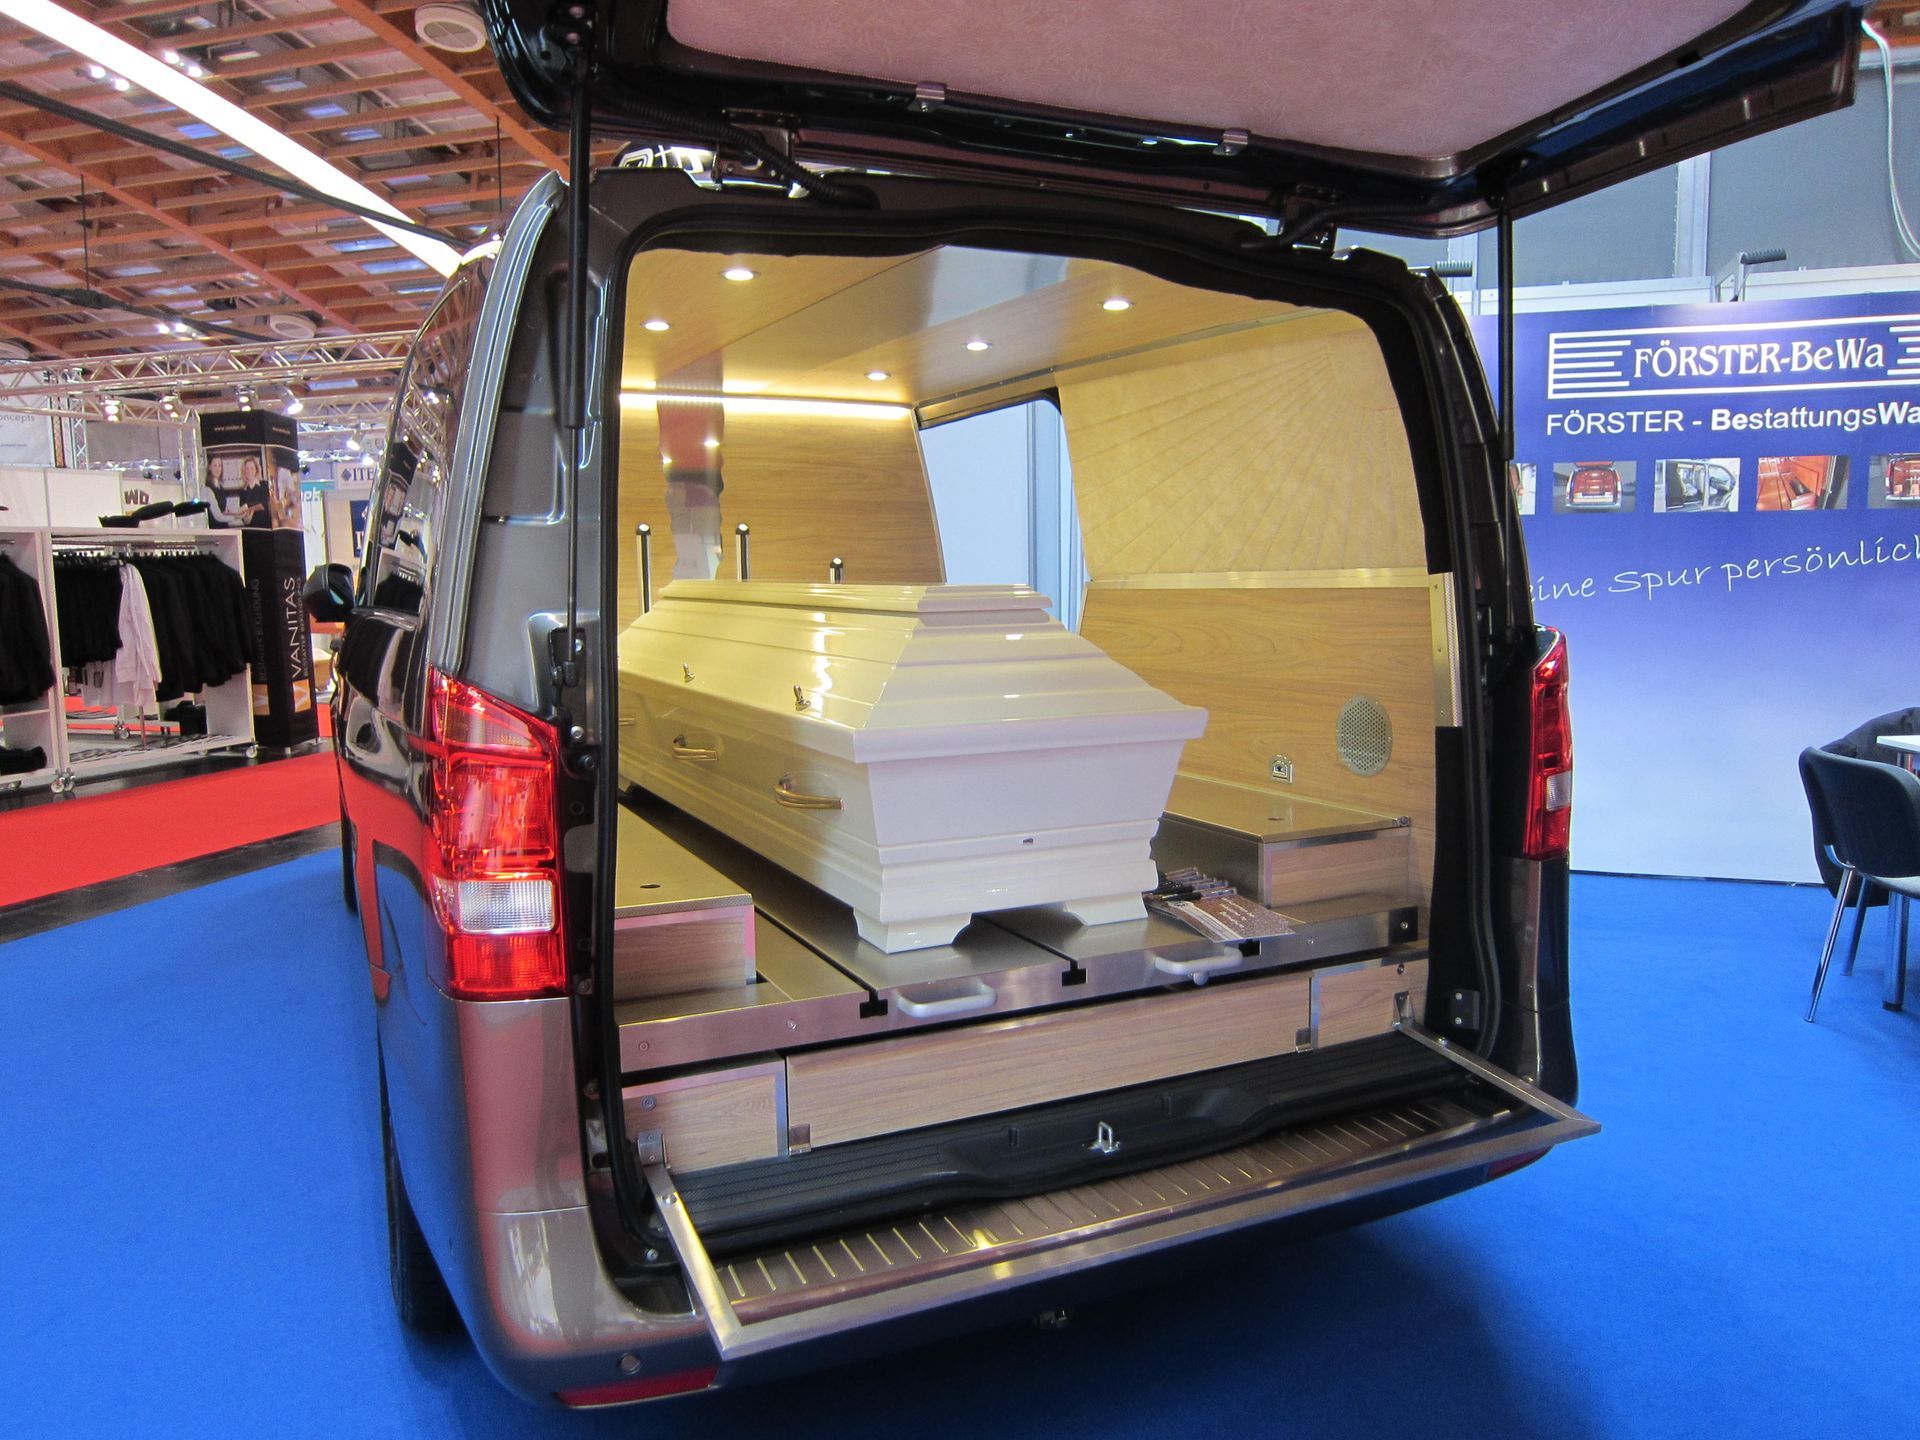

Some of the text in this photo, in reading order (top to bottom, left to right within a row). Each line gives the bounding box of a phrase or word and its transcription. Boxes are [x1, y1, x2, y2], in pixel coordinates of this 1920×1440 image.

[1633, 338, 1885, 378] FÖRSTER-BeWa
[1547, 409, 1684, 436] FÖRSTER
[1711, 401, 1920, 432] BestattungsWa
[301, 486, 321, 503] ek
[1608, 565, 1711, 601] Spur
[283, 577, 302, 678] VANITAS
